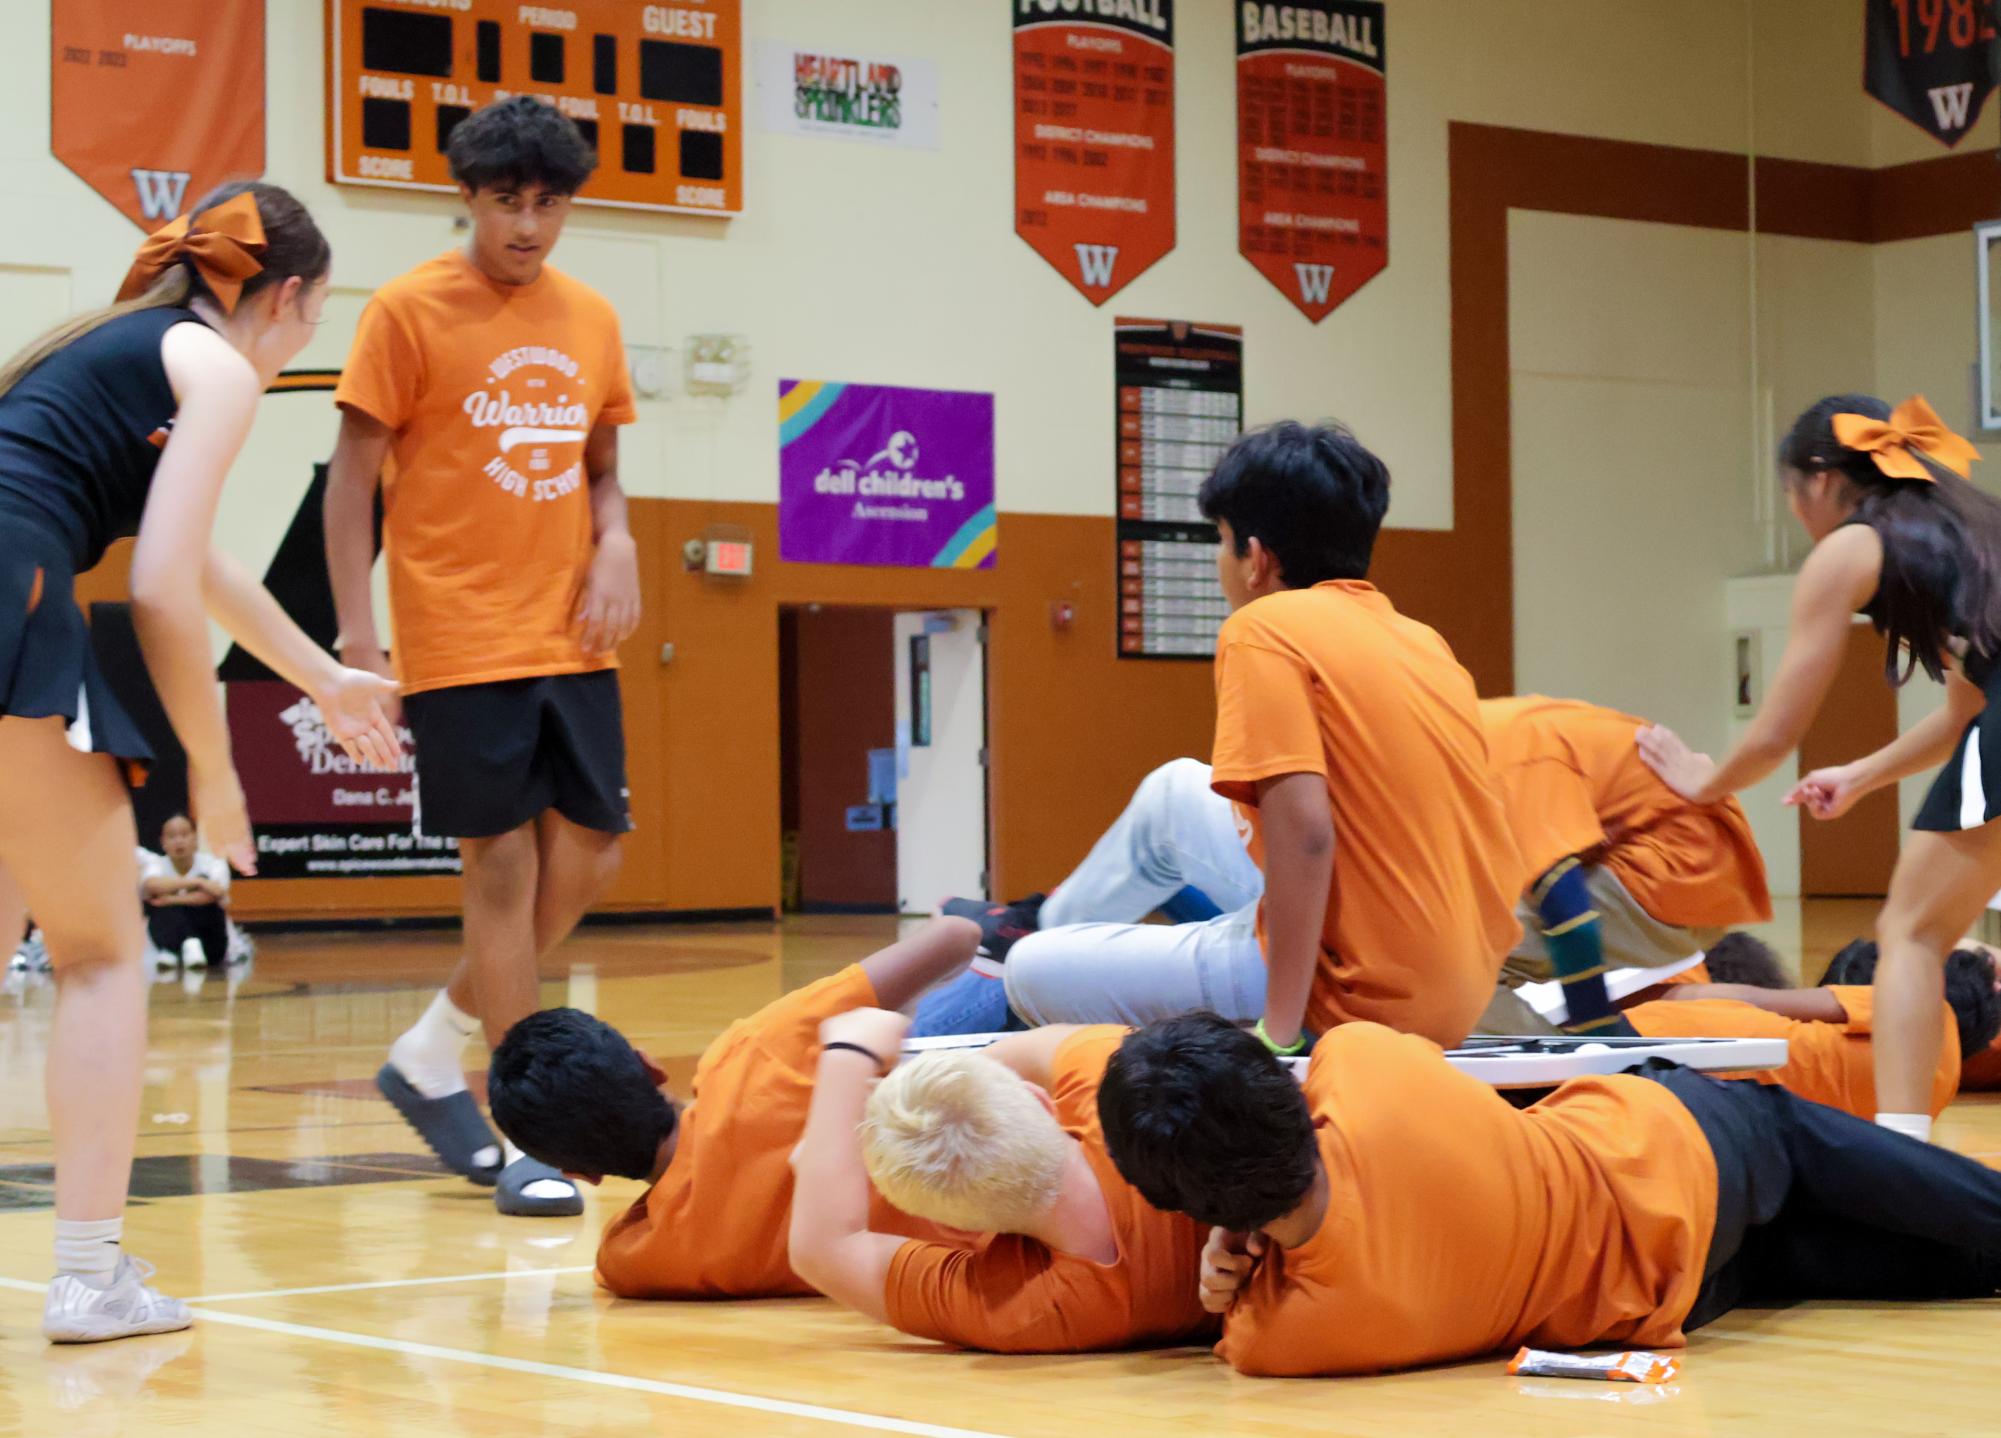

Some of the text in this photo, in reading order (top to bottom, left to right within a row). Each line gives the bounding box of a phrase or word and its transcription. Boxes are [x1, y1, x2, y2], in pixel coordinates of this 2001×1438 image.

[518, 6, 577, 29] PERIOD
[643, 5, 717, 39] GUEST
[1242, 1, 1378, 58] BASEBALL
[123, 33, 197, 57] PLAYOFFS
[794, 53, 902, 96] HEARTLAND
[359, 75, 414, 99] FOULS
[676, 108, 727, 131] FOULS
[1927, 81, 1974, 130] W
[1083, 129, 1154, 149] CHAMPIONS
[359, 156, 413, 179] SCORE
[130, 168, 191, 220] W
[676, 185, 726, 208] SCORE
[1044, 191, 1148, 213] AREA CHAMPIONS
[1074, 243, 1119, 287] W
[1294, 262, 1335, 304] W
[482, 456, 528, 497] HIGH
[815, 468, 964, 500] dell children's
[853, 502, 928, 521] Ascension
[332, 788, 373, 806] Dana
[376, 788, 394, 806] C.
[258, 834, 309, 856] Expert
[312, 834, 347, 852] Skin
[349, 833, 385, 851] Care
[387, 833, 413, 850] For
[416, 836, 443, 850] The
